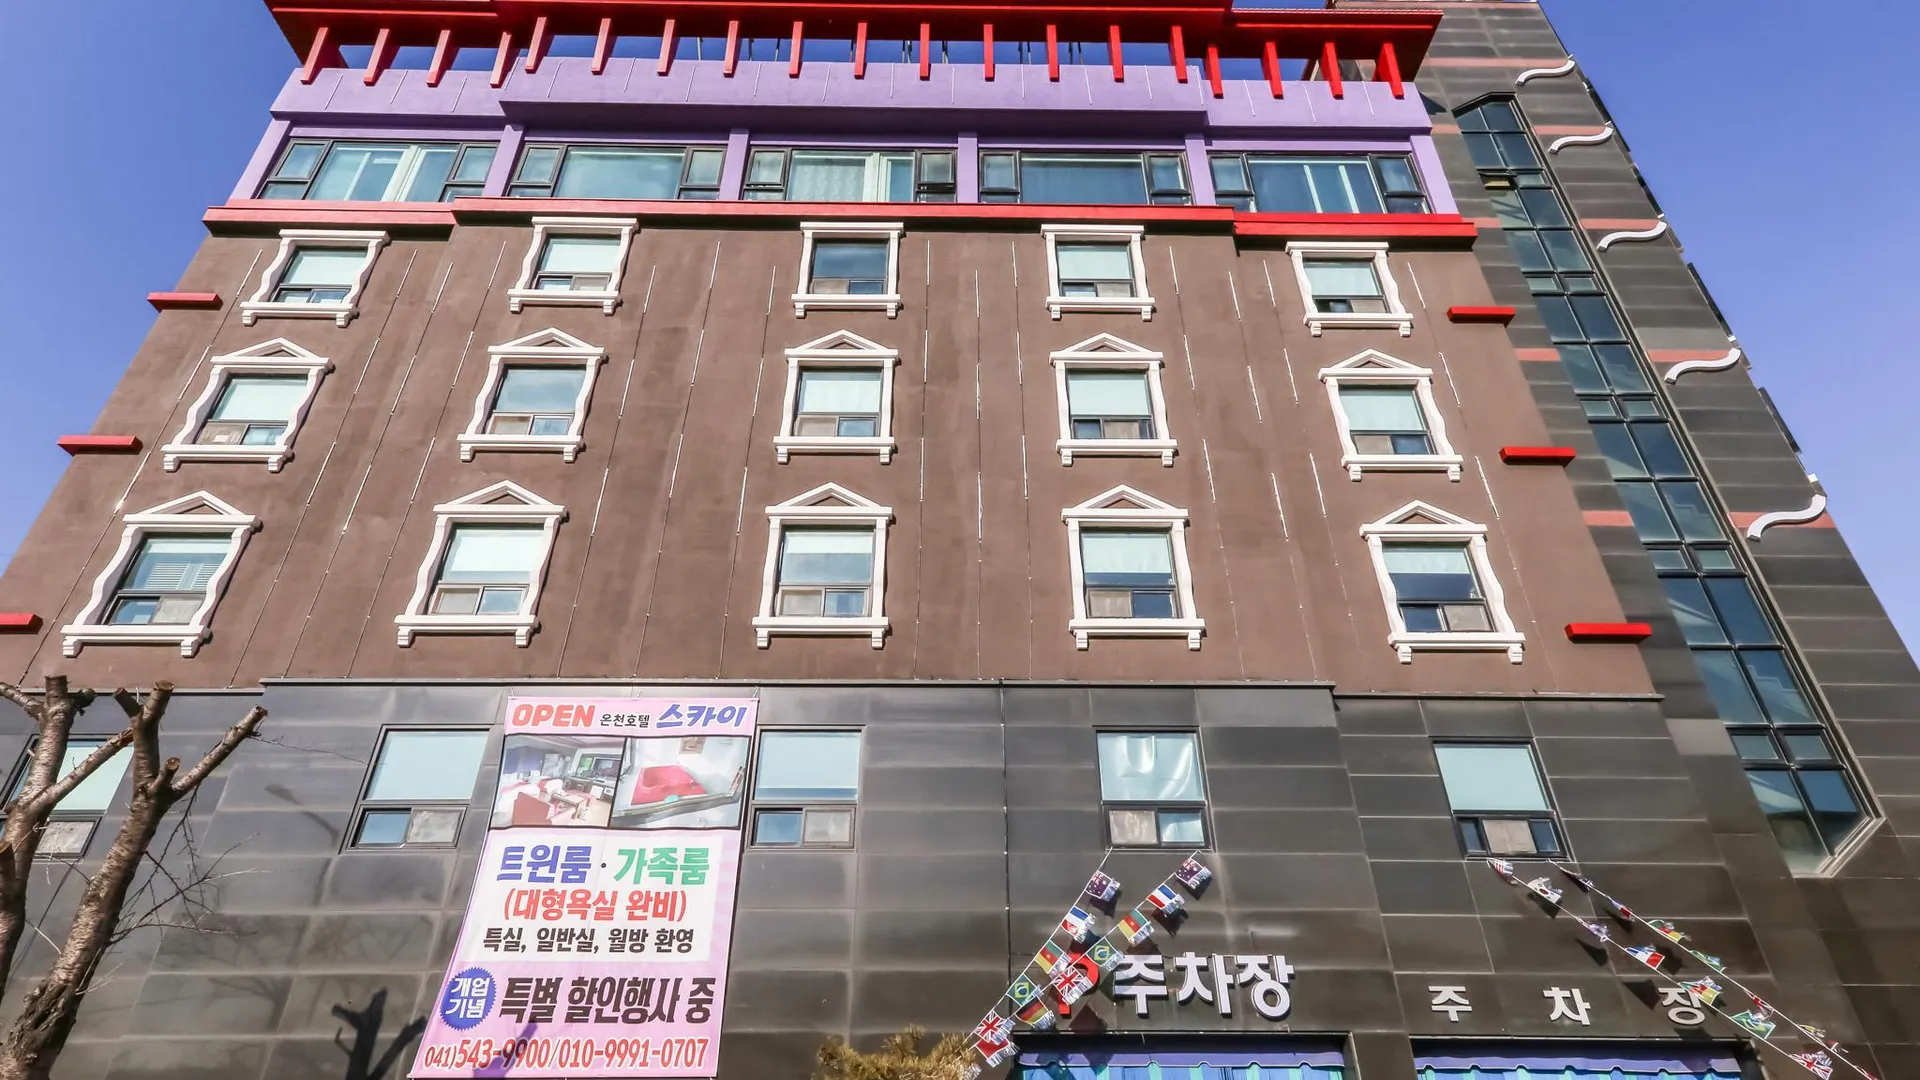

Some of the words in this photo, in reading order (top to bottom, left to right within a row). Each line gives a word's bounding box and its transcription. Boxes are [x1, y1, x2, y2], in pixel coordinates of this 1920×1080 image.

[512, 704, 595, 728] OPEN
[600, 713, 650, 728] 온천호텔
[656, 704, 747, 729] 스카이
[497, 845, 592, 883] 트윈룸
[614, 848, 709, 885] 가족룸
[504, 888, 618, 921] (대형욕실
[626, 890, 687, 922] 완비)
[483, 928, 527, 953] 특실,
[536, 928, 600, 954] 일반실,
[608, 928, 649, 953] 월방
[654, 928, 694, 953] 환영
[451, 977, 490, 997] 개업
[499, 977, 563, 1023] 특별
[564, 977, 682, 1024] 할인행사
[685, 978, 716, 1023] 중
[1114, 952, 1294, 1019] 주차장
[445, 998, 486, 1018] 기념
[424, 1038, 709, 1068] 041)543-9900/010-9991-0707
